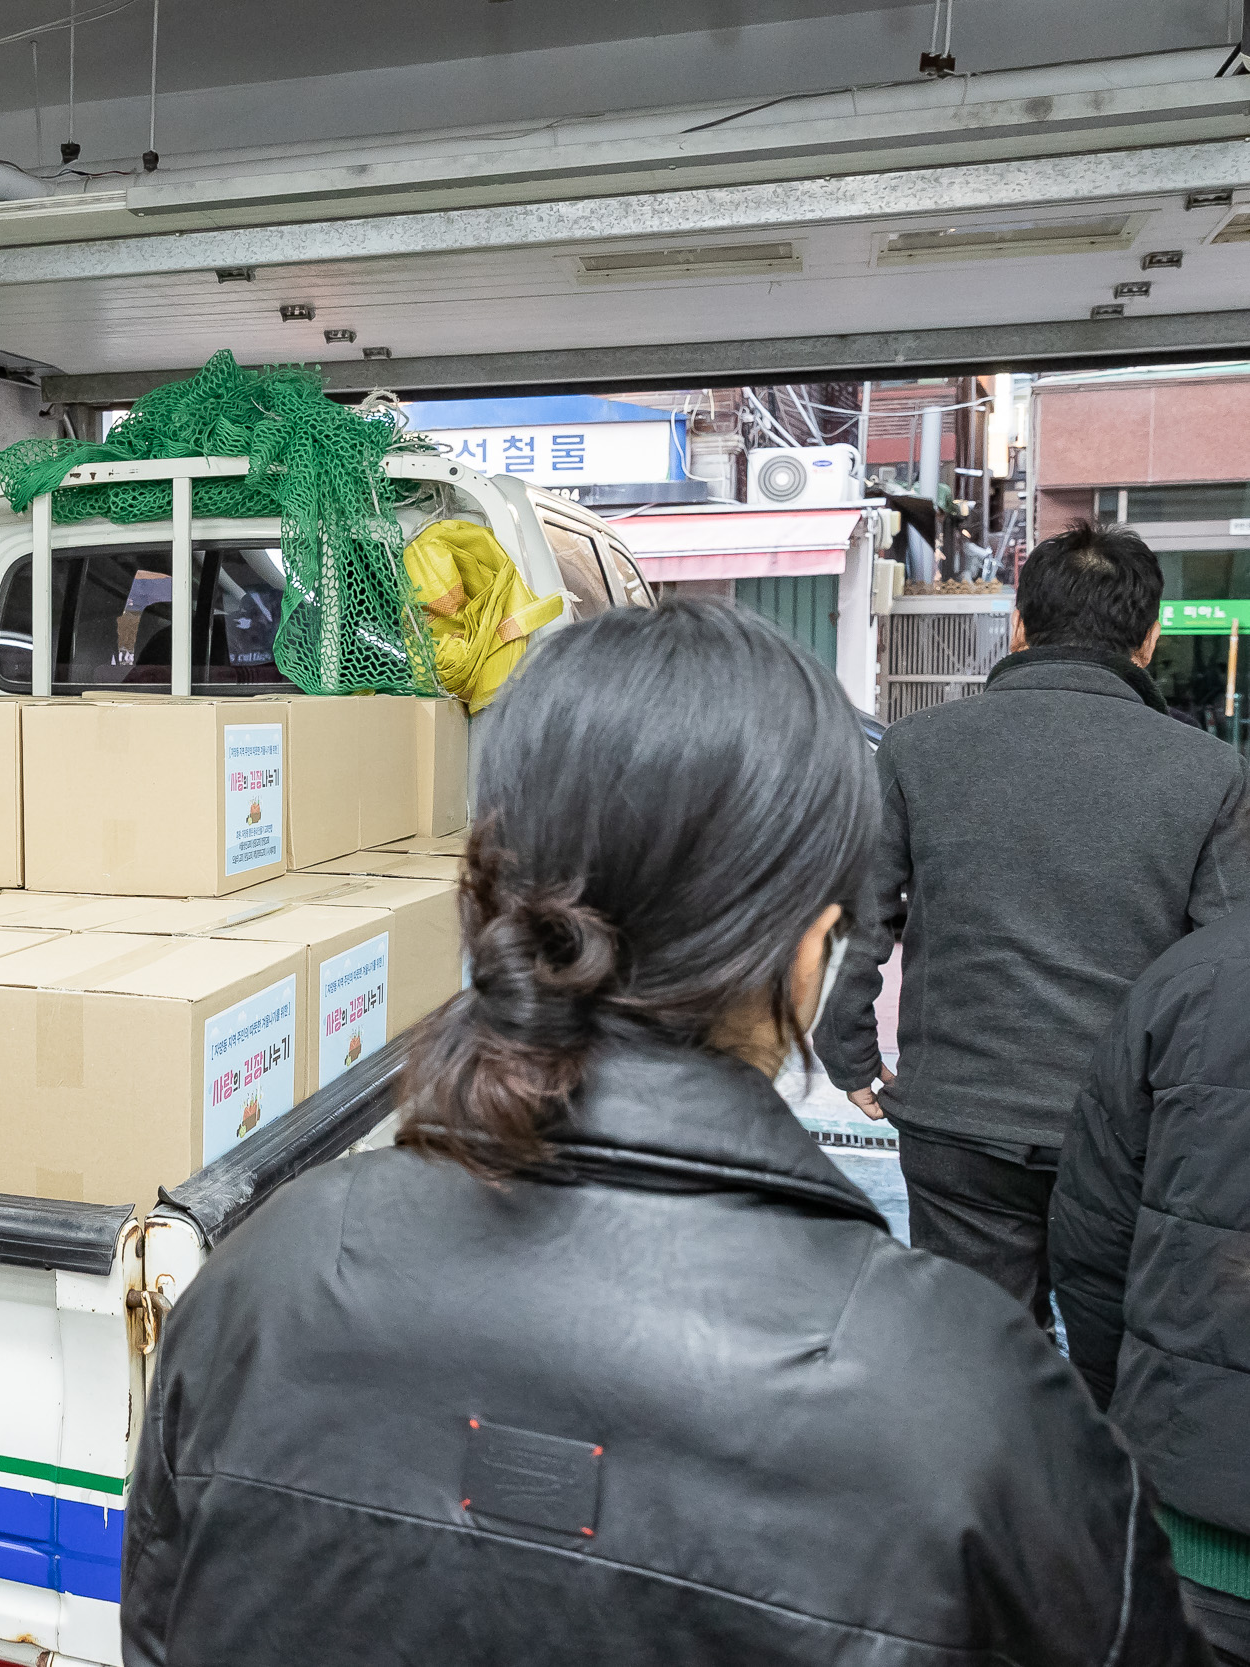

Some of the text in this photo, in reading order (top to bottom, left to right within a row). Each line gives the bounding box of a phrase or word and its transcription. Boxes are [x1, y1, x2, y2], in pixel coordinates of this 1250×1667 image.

[436, 434, 585, 474] 선철물
[230, 768, 280, 791] 사랑의 김장나누기
[326, 983, 384, 1037] 사랑의 김장나누기
[212, 1034, 291, 1107] 사랑의 김장나누기
